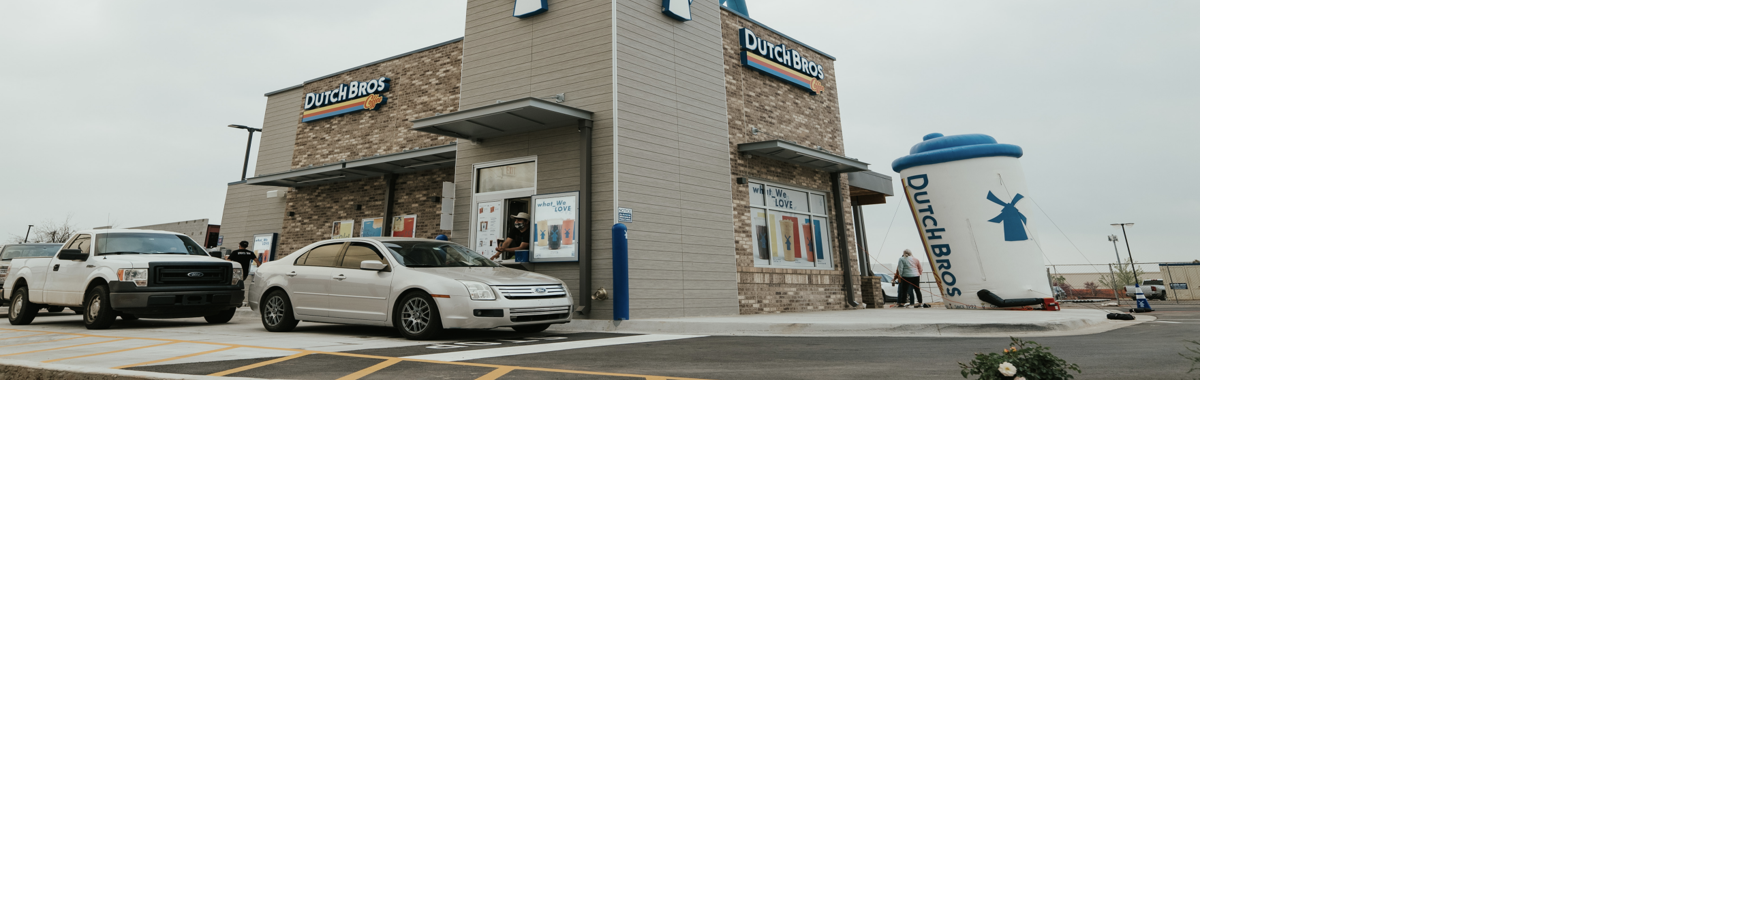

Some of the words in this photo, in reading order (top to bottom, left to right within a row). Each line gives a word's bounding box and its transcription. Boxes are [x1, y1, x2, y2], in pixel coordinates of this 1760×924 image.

[792, 49, 825, 80] BROS
[348, 77, 387, 99] BROS
[554, 205, 572, 213] LOVE
[775, 198, 793, 209] LOVE
[930, 243, 962, 297] BROS
